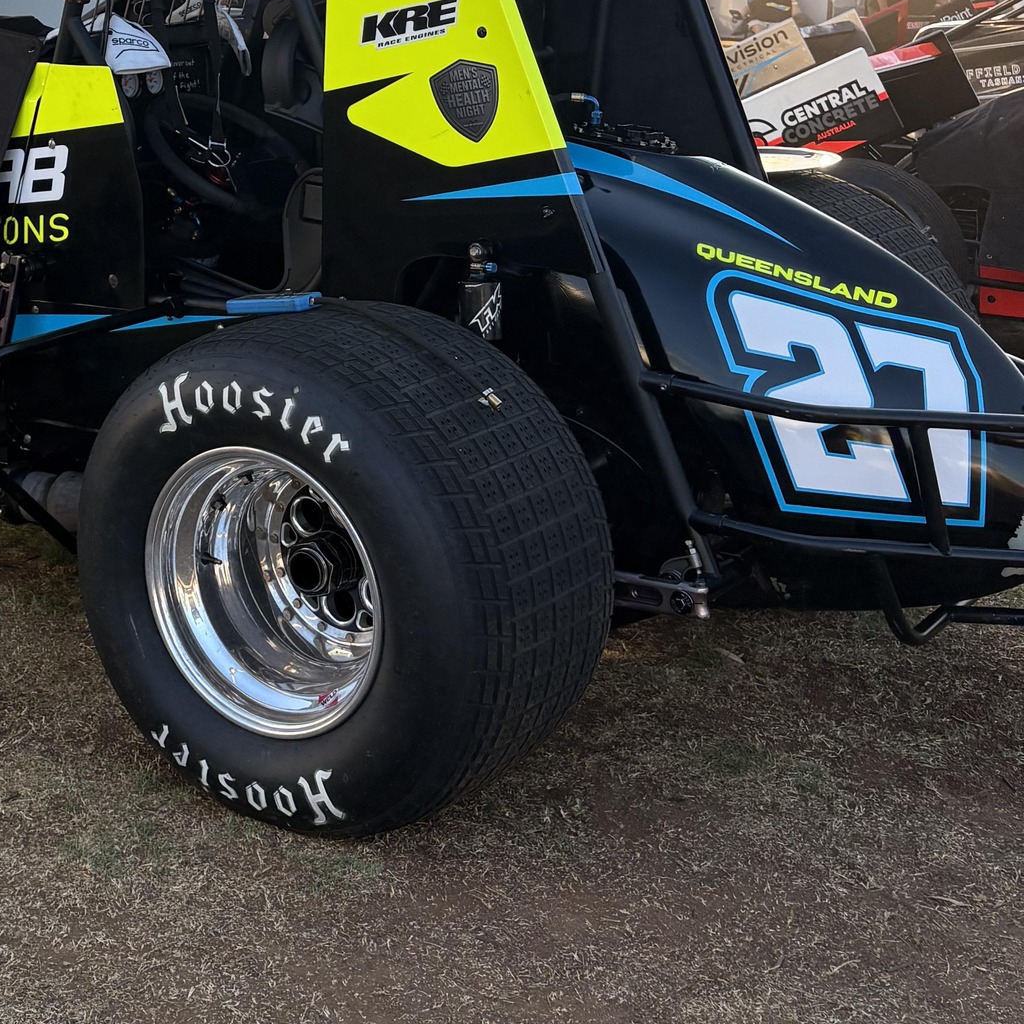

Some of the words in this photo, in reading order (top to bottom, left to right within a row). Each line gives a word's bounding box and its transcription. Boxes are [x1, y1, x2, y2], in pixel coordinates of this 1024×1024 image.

[940, 7, 973, 22] Point
[111, 37, 150, 48] sparco
[377, 38, 402, 48] RACE
[405, 28, 446, 42] ENGINES
[727, 29, 789, 64] vision
[450, 66, 478, 82] MEN'S
[450, 78, 483, 94] MENTAL
[448, 89, 490, 108] HEALTH
[783, 83, 867, 126] CENTRAL
[456, 103, 485, 119] NIGHT
[784, 93, 879, 143] CONCRETE
[817, 120, 856, 141] AUSTRALIA
[696, 242, 898, 309] QUEENSLAND
[728, 290, 971, 508] 27
[159, 370, 351, 463] Hoosier
[151, 723, 346, 825] Hoosier
